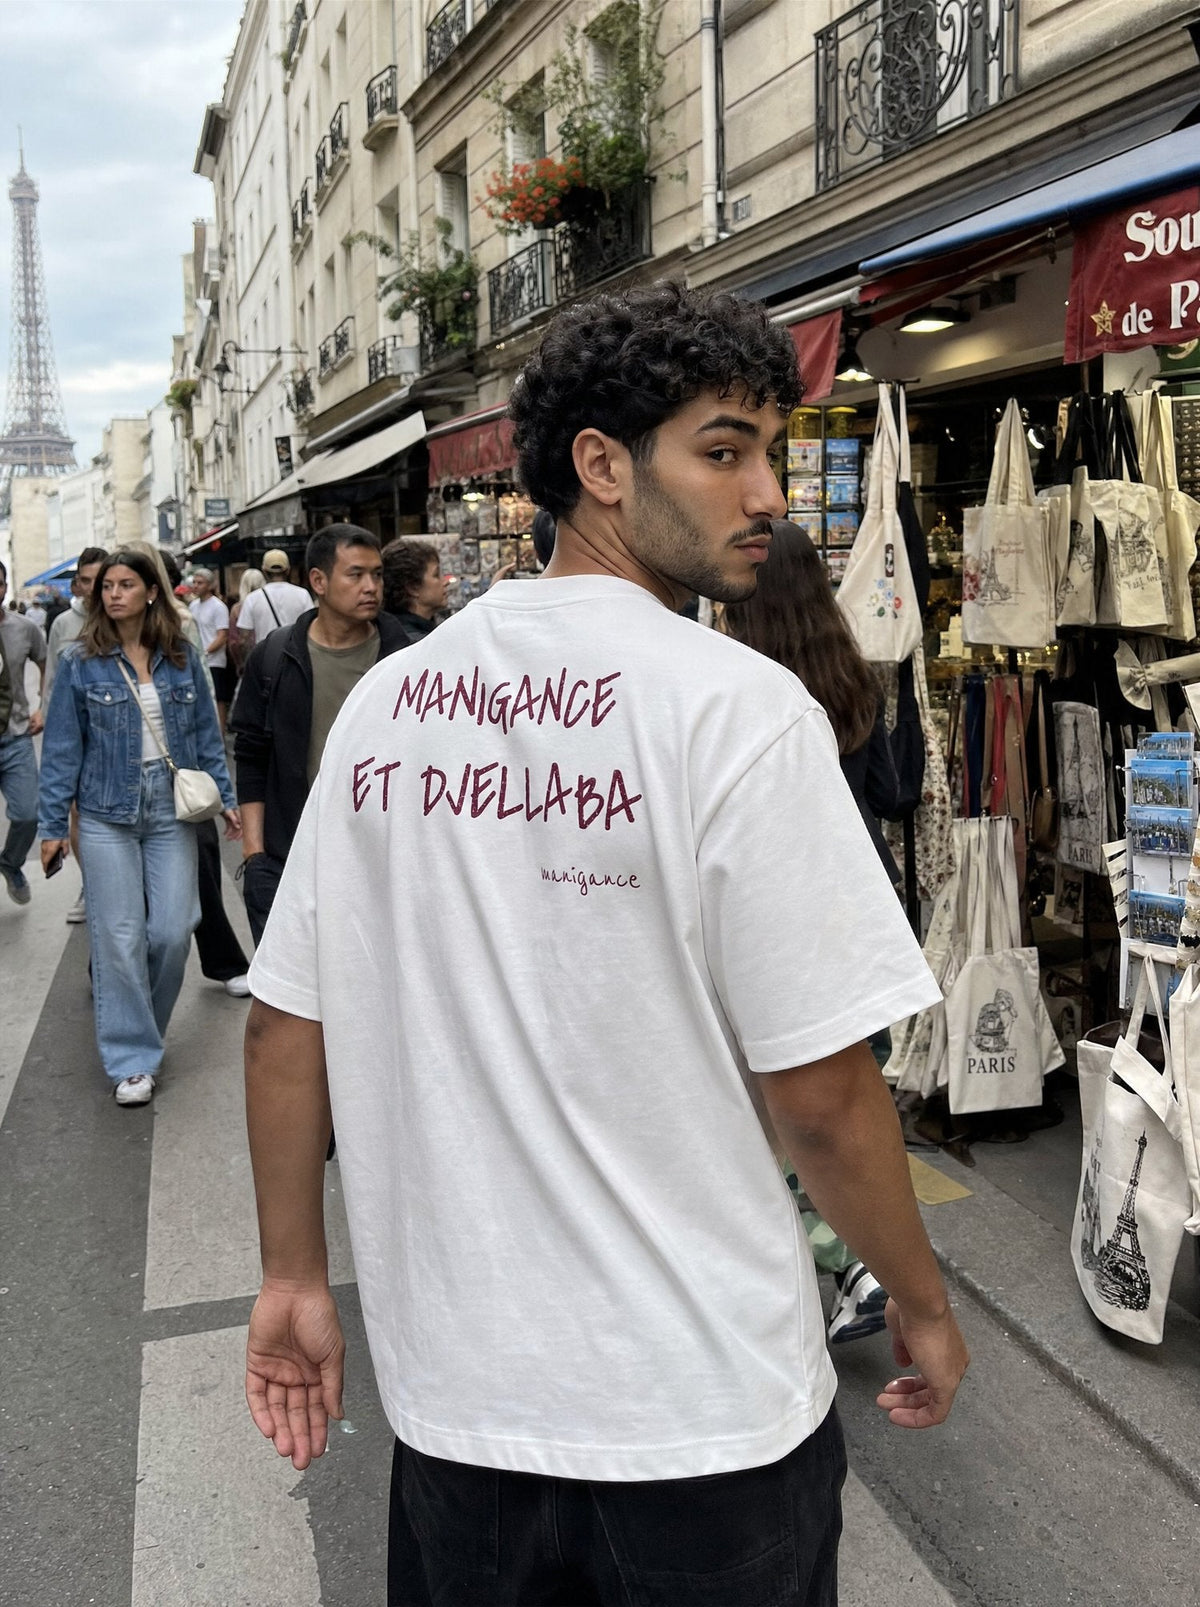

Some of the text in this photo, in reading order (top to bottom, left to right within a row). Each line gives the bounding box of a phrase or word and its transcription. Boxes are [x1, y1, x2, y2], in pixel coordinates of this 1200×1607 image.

[1123, 210, 1200, 263] Sou
[1121, 279, 1200, 337] de P
[393, 666, 621, 735] MANIGANCE
[352, 756, 642, 831] ET DJELLABA
[541, 867, 641, 896] manigance
[967, 1056, 1016, 1074] PARIS
